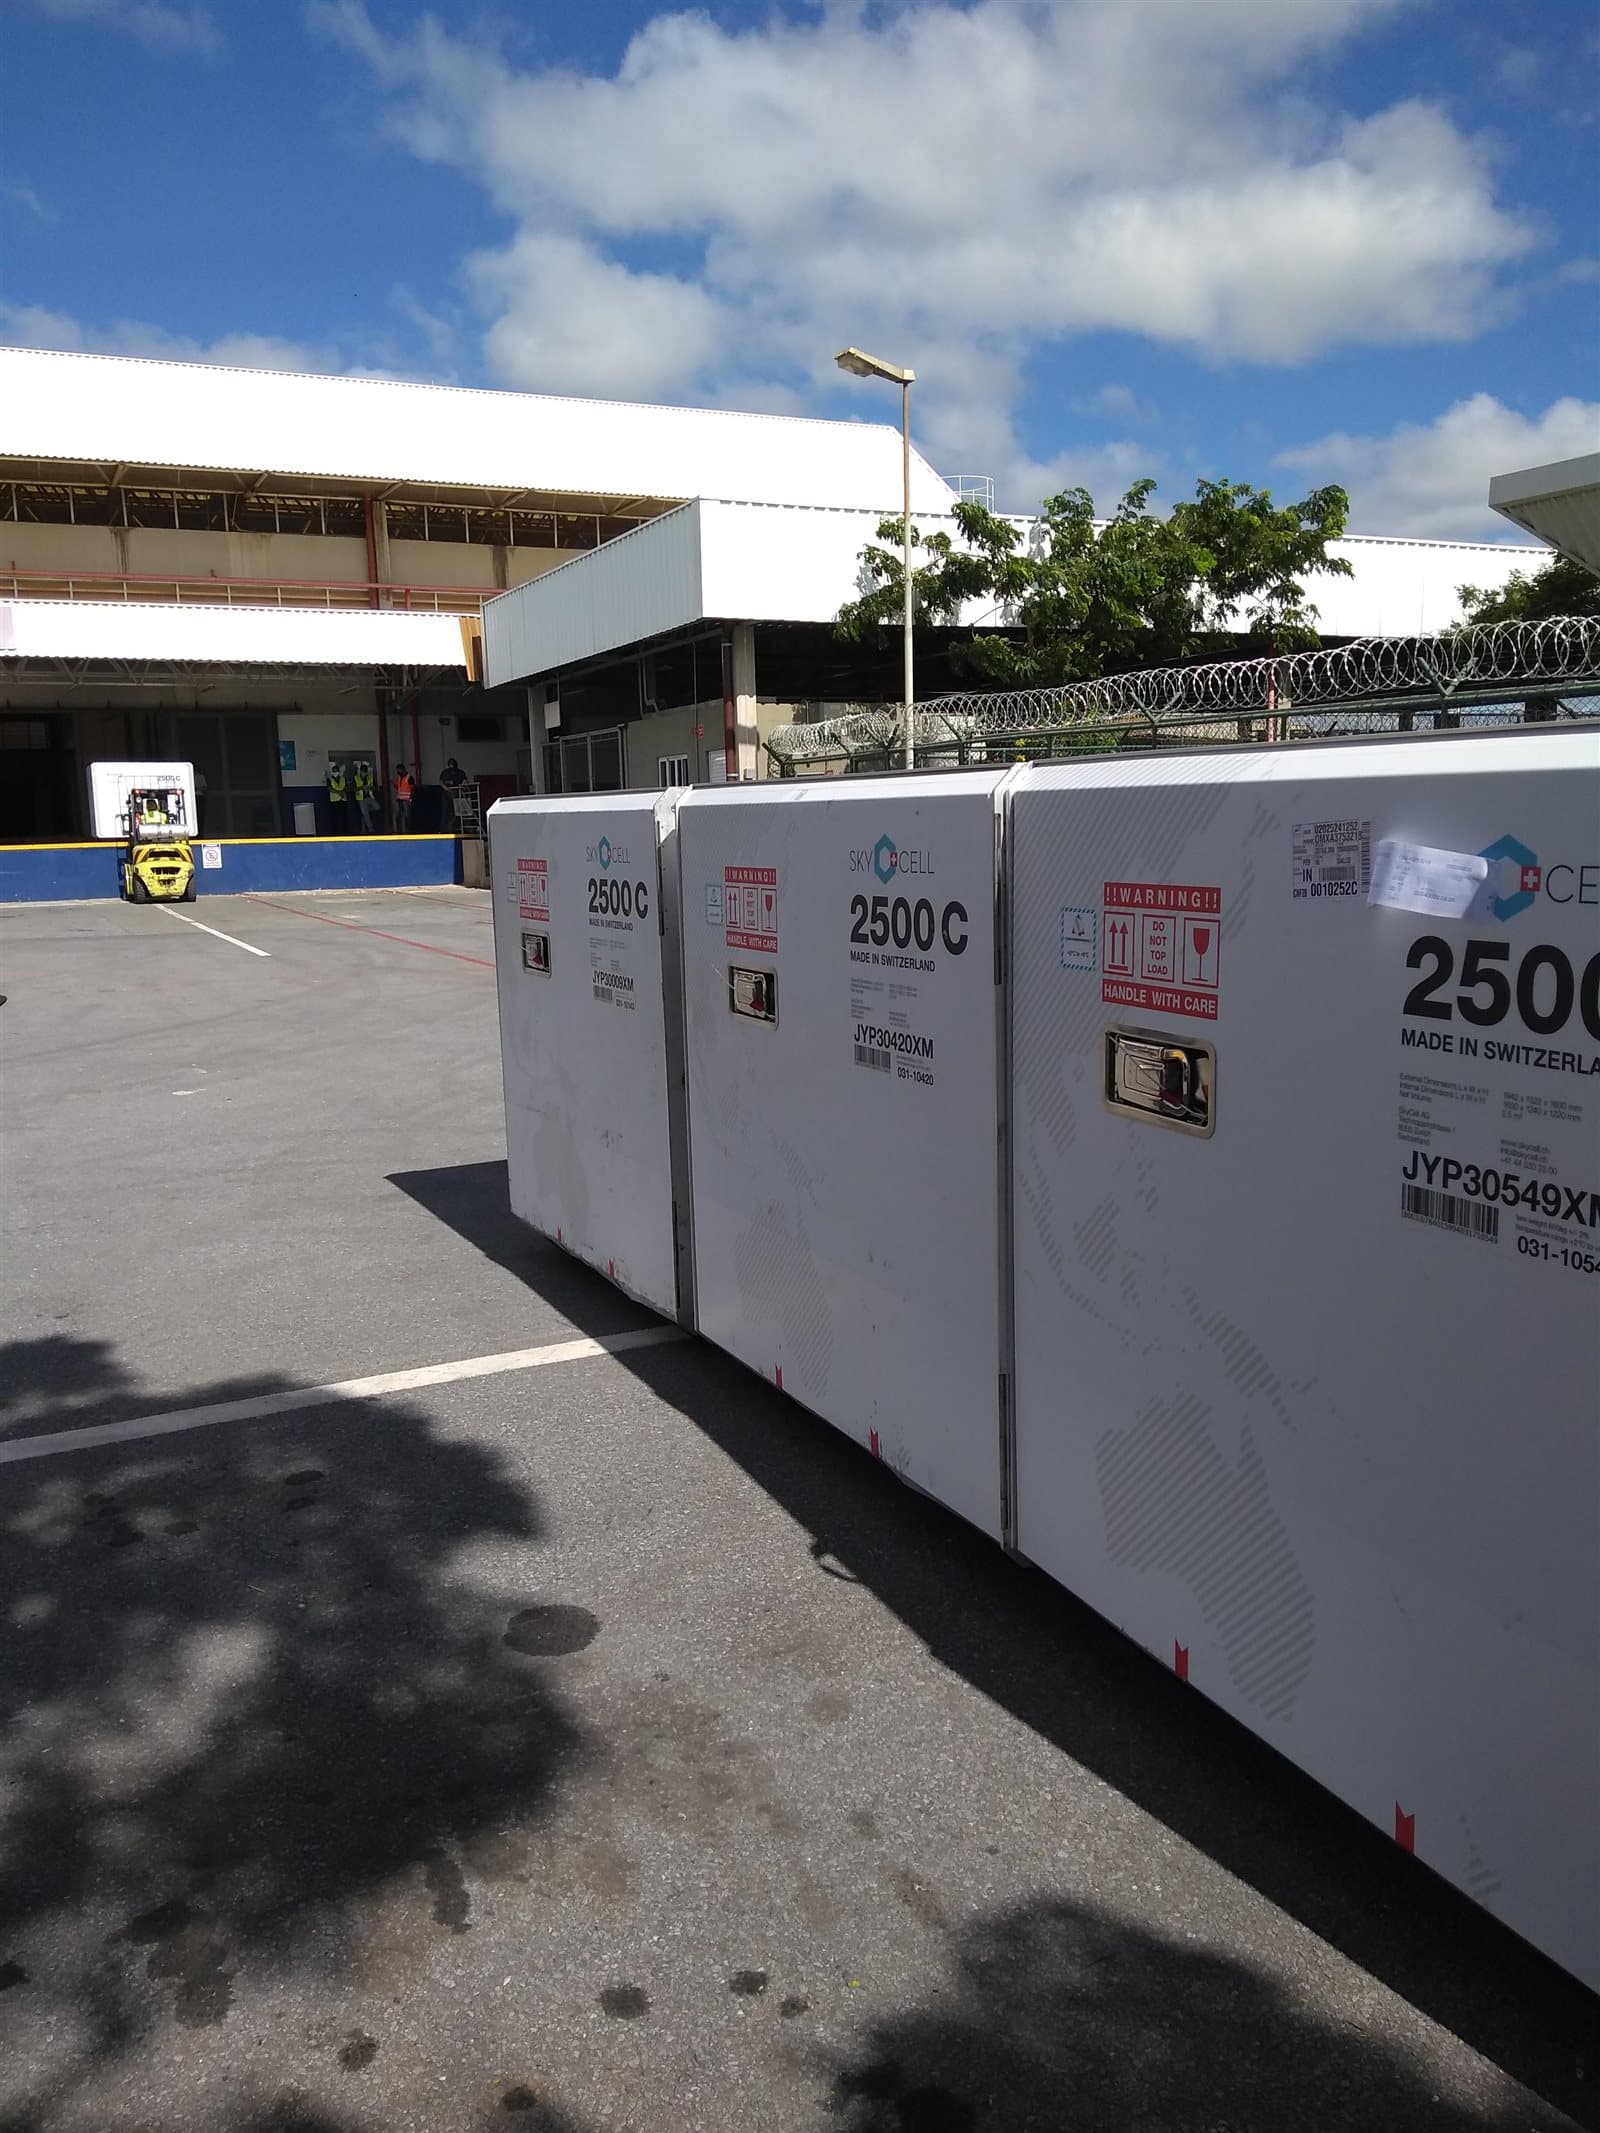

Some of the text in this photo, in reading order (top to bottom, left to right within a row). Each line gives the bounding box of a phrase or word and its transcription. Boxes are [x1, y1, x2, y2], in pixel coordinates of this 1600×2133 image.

[611, 847, 632, 864] CELL
[849, 850, 935, 874] SKY CELL
[1302, 868, 1312, 882] IN
[588, 877, 648, 919] 2500 C
[1106, 887, 1217, 909] !!WARNING!!
[1311, 881, 1358, 897] 0010252C
[850, 894, 968, 956] 2500 C
[1152, 920, 1165, 932] DO
[1150, 935, 1168, 946] NOT
[850, 950, 936, 972] MADE IN SWITZERLAND
[1150, 950, 1167, 960] TOP
[1147, 964, 1168, 975] LOAD
[1105, 984, 1216, 1014] HANDLE WITH CARE
[854, 1023, 934, 1060] JYP30420XM
[1402, 1028, 1454, 1053] MADE
[1459, 1036, 1478, 1057] IN
[897, 1066, 934, 1086] 031-10420
[1402, 1150, 1600, 1228] JYP30549X
